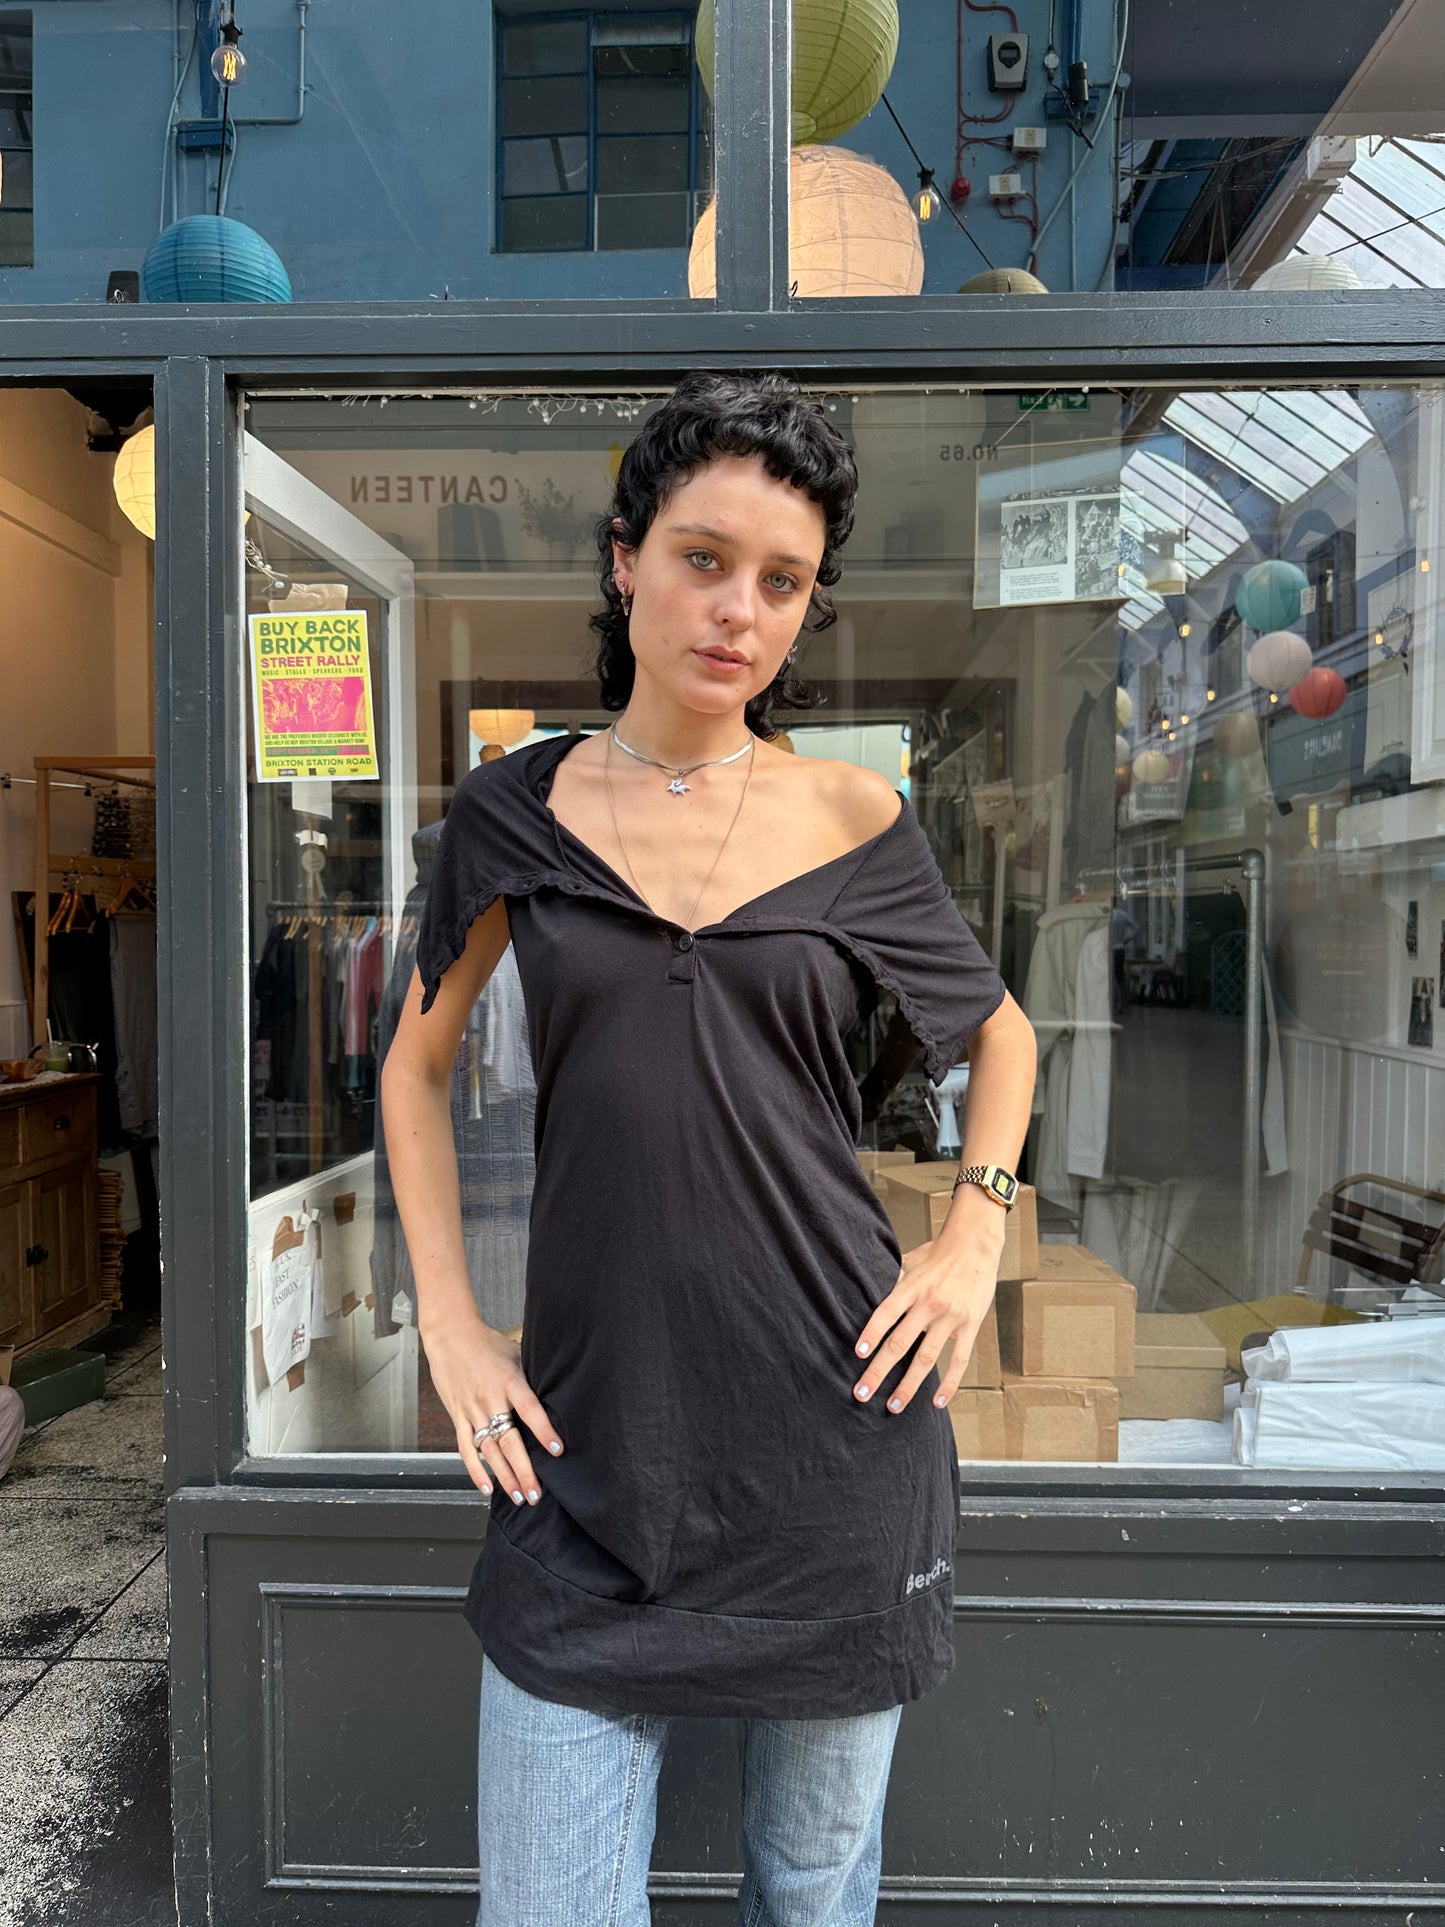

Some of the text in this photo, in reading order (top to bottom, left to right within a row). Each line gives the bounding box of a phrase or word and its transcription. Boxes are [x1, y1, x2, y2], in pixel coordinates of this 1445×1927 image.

[259, 619, 360, 636] BUY BACK
[260, 635, 362, 655] BRIXTON
[260, 655, 360, 668] STREET RALLY
[266, 760, 304, 768] BRIXTON
